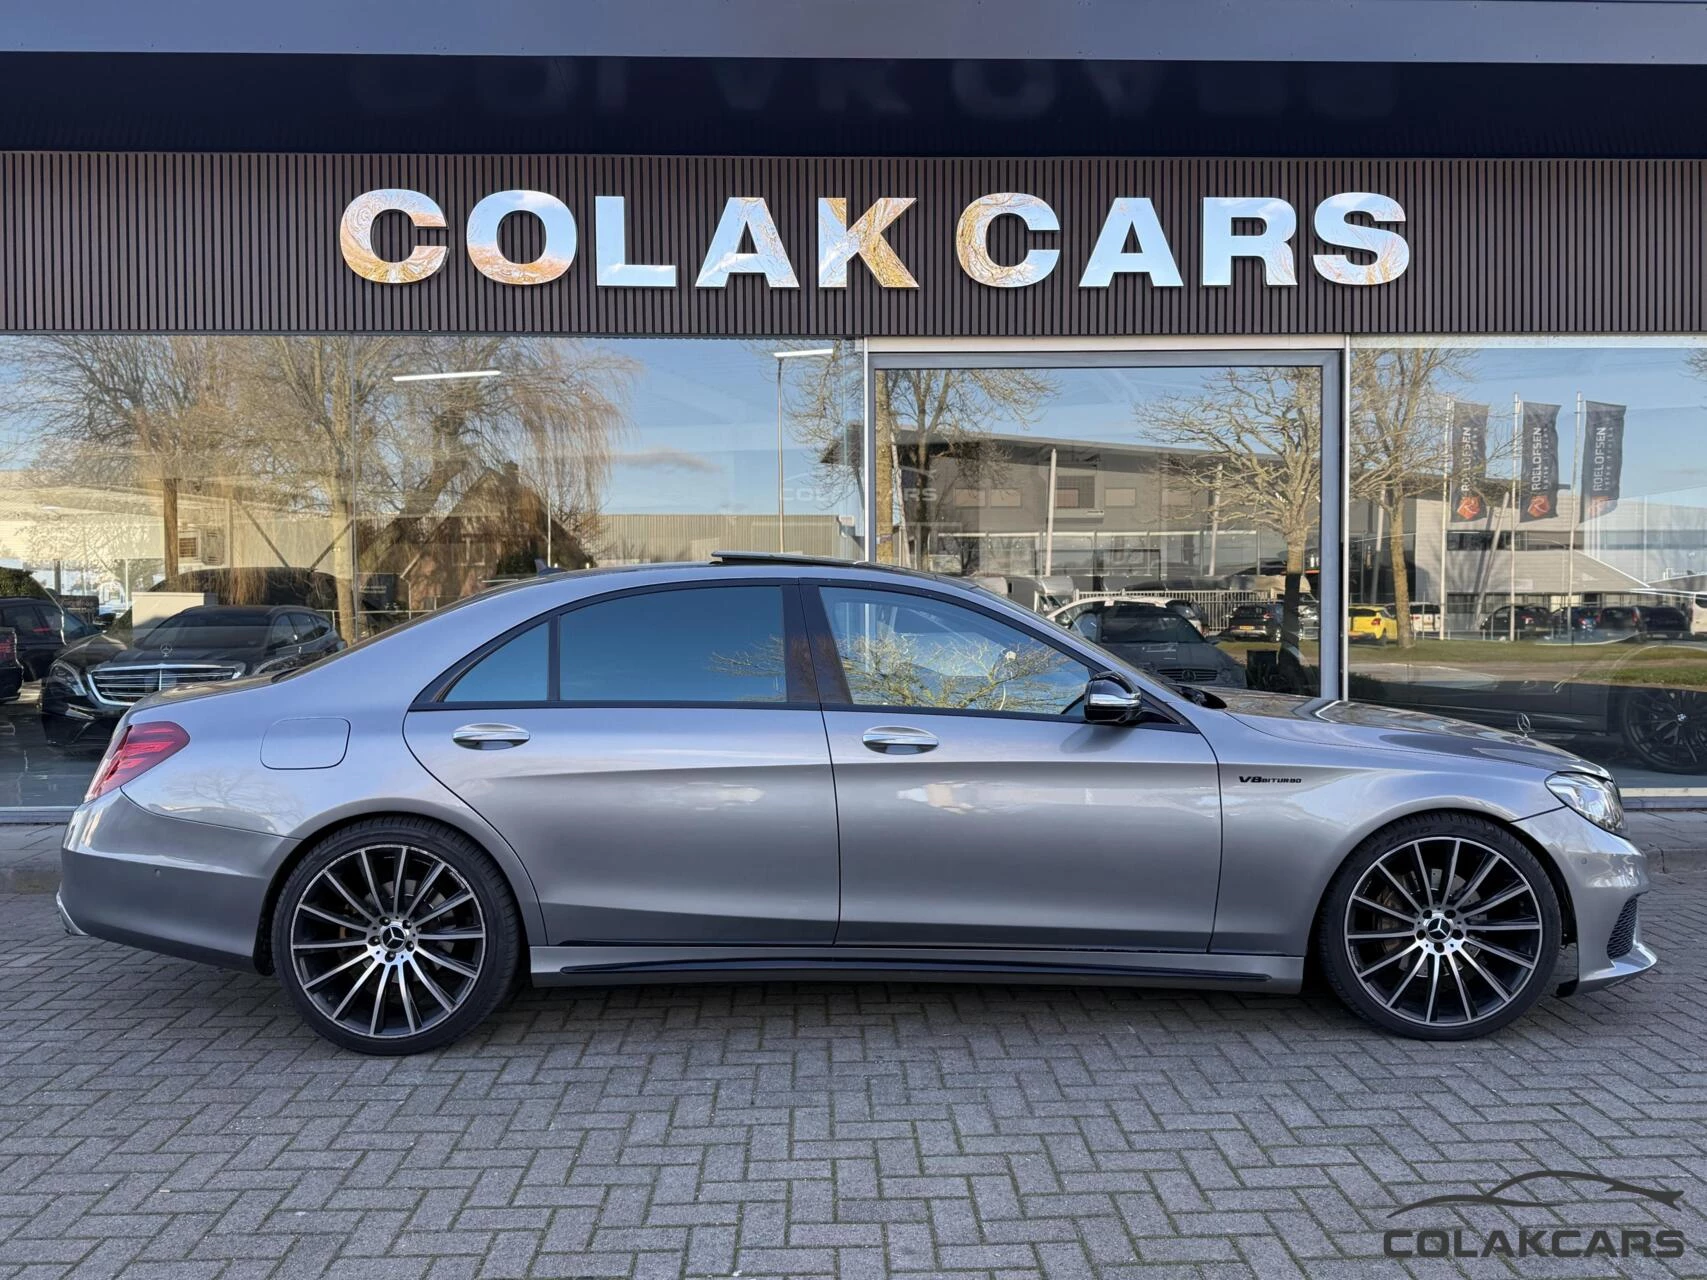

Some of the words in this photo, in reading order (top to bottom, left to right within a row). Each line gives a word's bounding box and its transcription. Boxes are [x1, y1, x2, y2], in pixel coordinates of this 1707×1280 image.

[340, 188, 920, 289] COLAK
[956, 192, 1410, 289] CARS
[1461, 426, 1473, 492] ROLOFSEN
[1531, 427, 1543, 491] ROELOFSEN
[1592, 426, 1606, 491] ROELOFSEN
